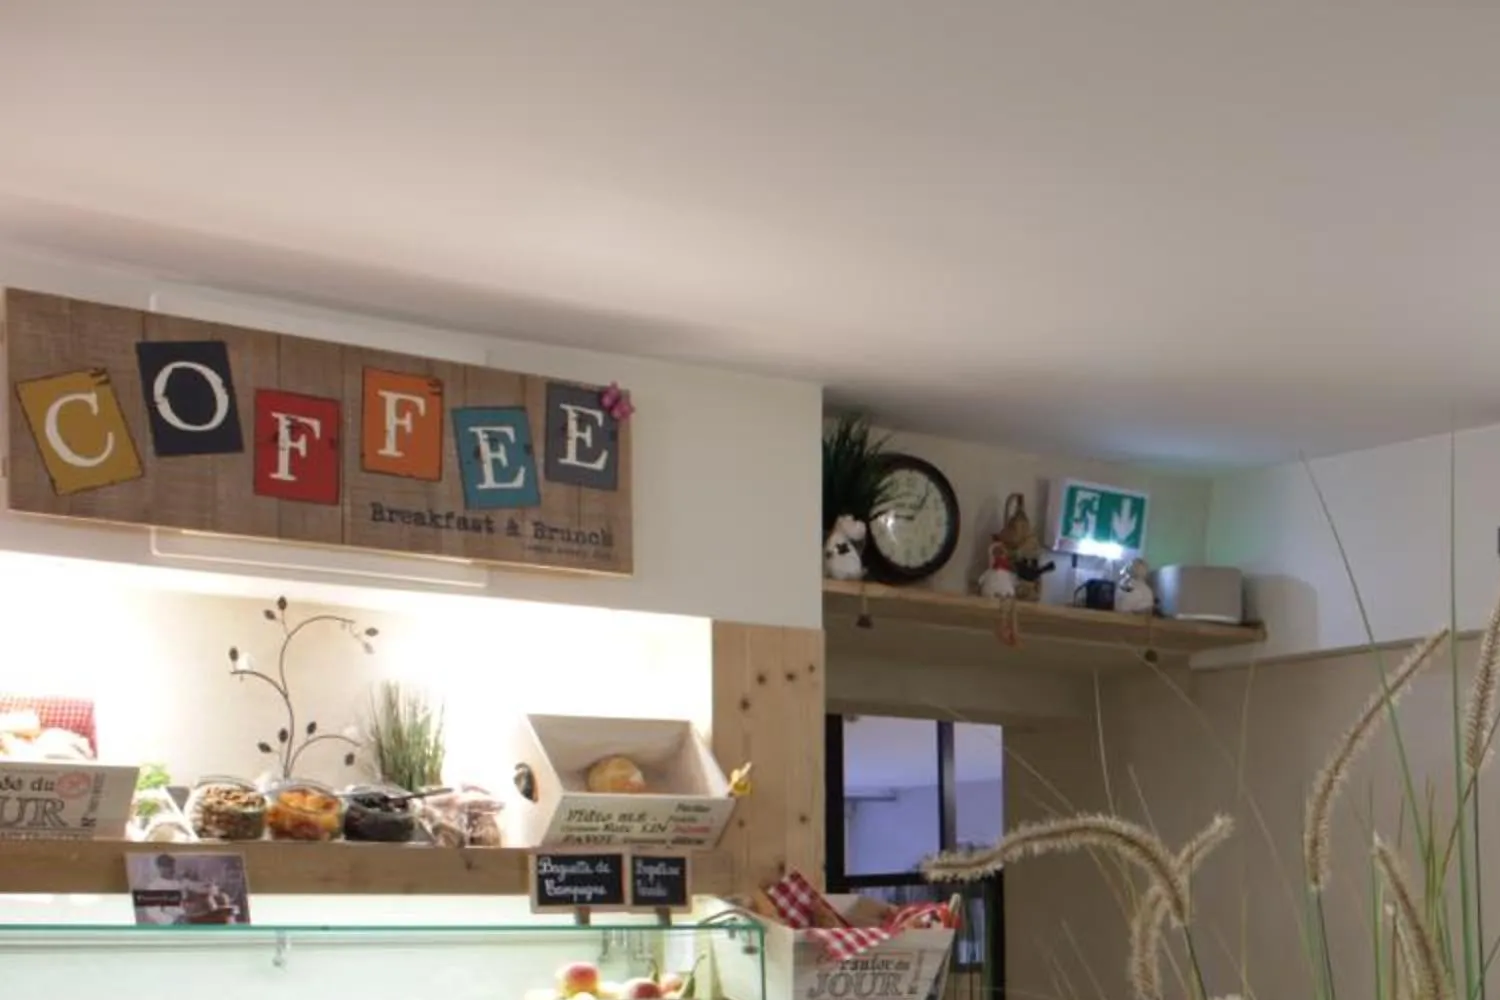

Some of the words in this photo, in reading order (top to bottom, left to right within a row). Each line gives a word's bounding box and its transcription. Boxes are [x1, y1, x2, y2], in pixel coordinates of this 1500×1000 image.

[44, 360, 609, 490] COFFEE
[370, 502, 495, 535] Breakfast
[505, 518, 520, 538] &
[532, 519, 615, 548] Brunch
